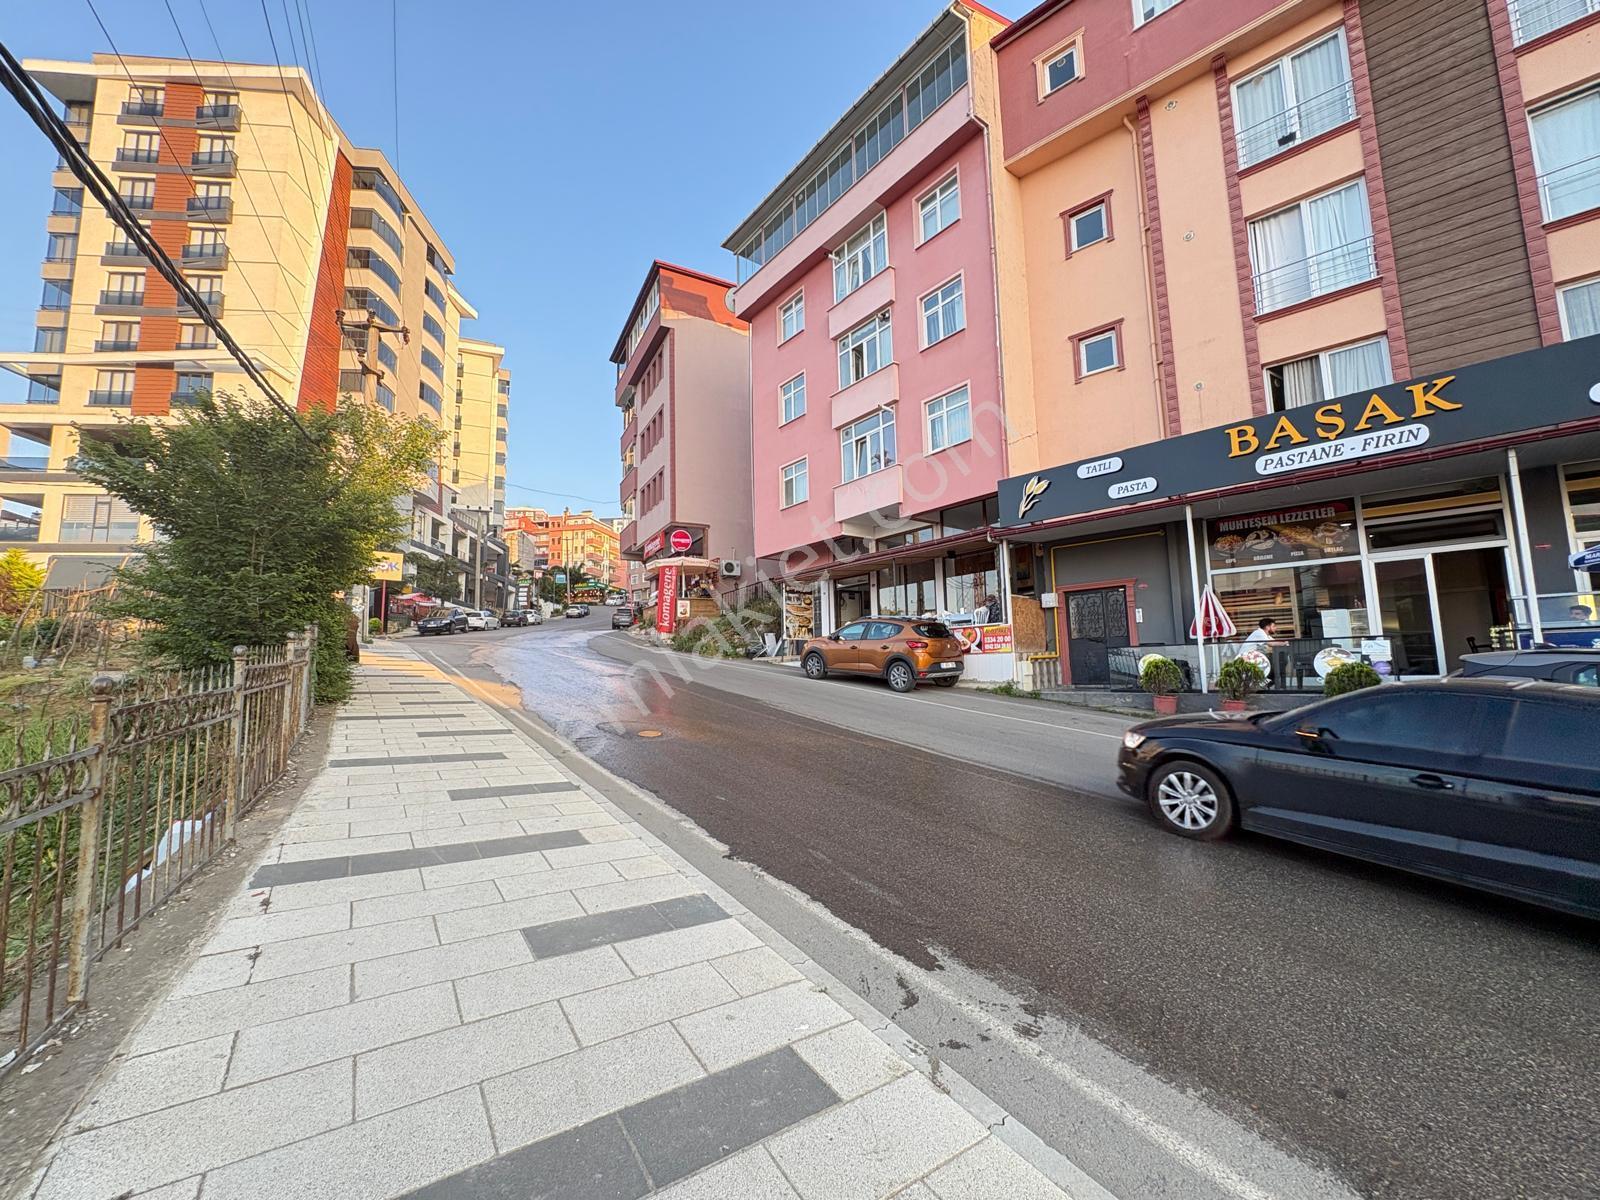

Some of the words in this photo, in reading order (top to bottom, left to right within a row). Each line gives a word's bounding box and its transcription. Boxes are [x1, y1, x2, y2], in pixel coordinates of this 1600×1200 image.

[1225, 375, 1463, 458] BAŞAK
[1262, 442, 1344, 471] PASTANE
[1361, 427, 1421, 455] FIRIN
[1085, 461, 1112, 474] TATLI
[1117, 481, 1148, 495] PASTA
[1219, 515, 1278, 532] MUHTEŞEM
[1280, 507, 1335, 523] LEZZETLER
[659, 568, 674, 627] komagene
